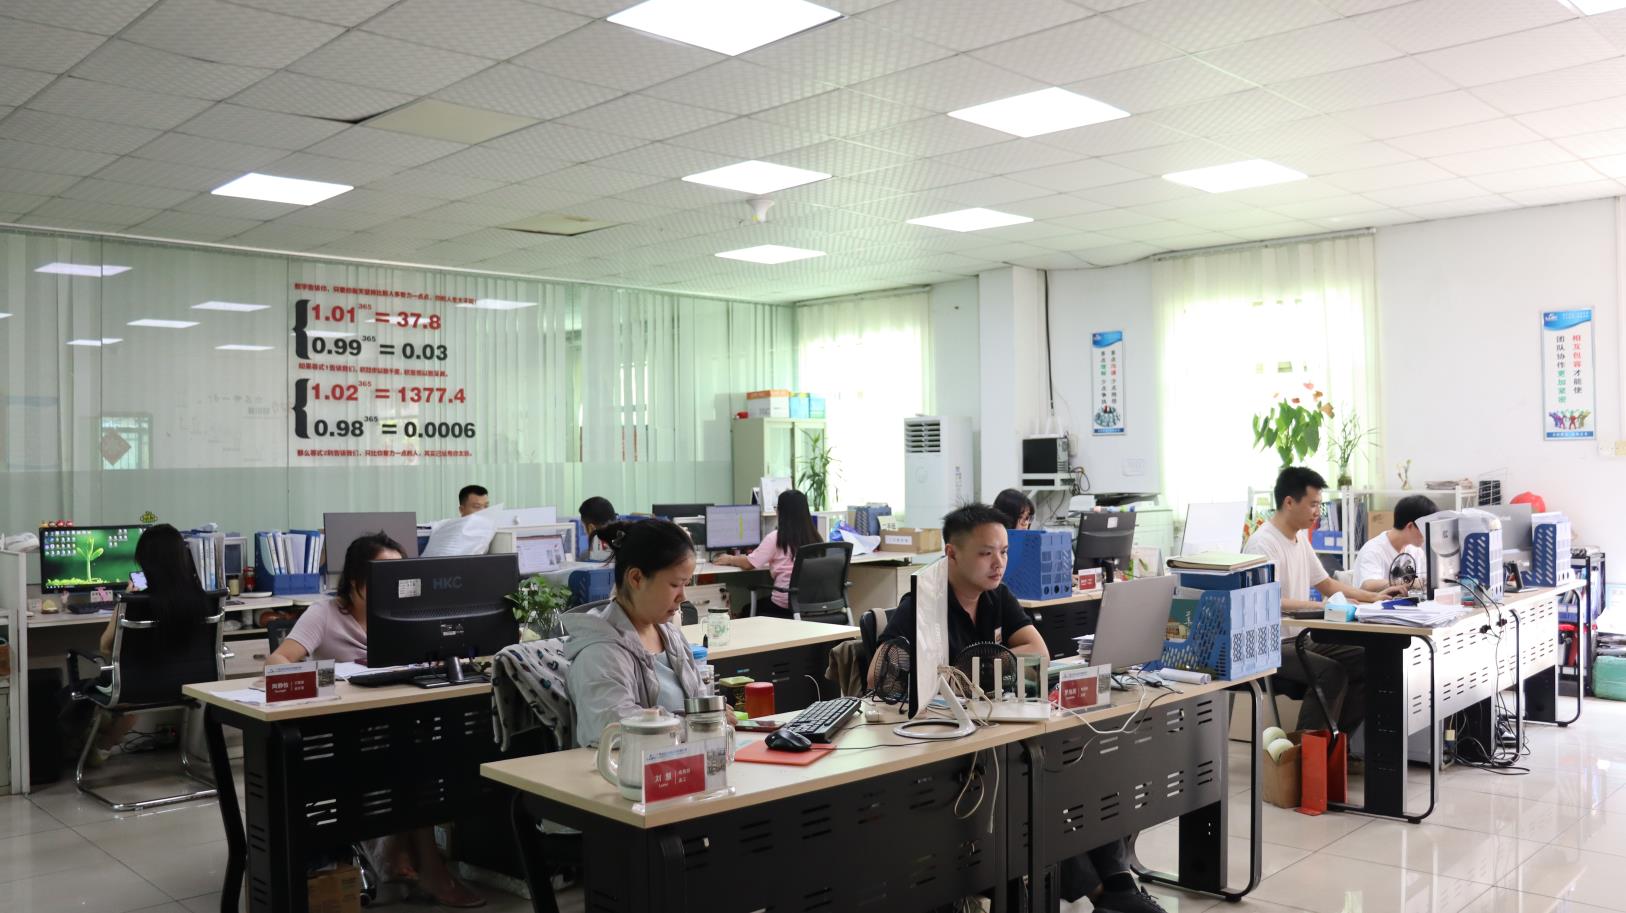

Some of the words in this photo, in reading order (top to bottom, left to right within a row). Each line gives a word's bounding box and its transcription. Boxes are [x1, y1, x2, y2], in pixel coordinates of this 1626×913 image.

[311, 303, 356, 323] 1.01
[397, 311, 441, 330] 37.8
[311, 337, 362, 356] 0.99
[402, 342, 448, 361] 0.03
[311, 383, 359, 401] 1.02
[398, 386, 466, 404] 1377.4
[313, 419, 364, 437] 0.98
[404, 421, 476, 439] 0.0006
[432, 576, 463, 590] HKC
